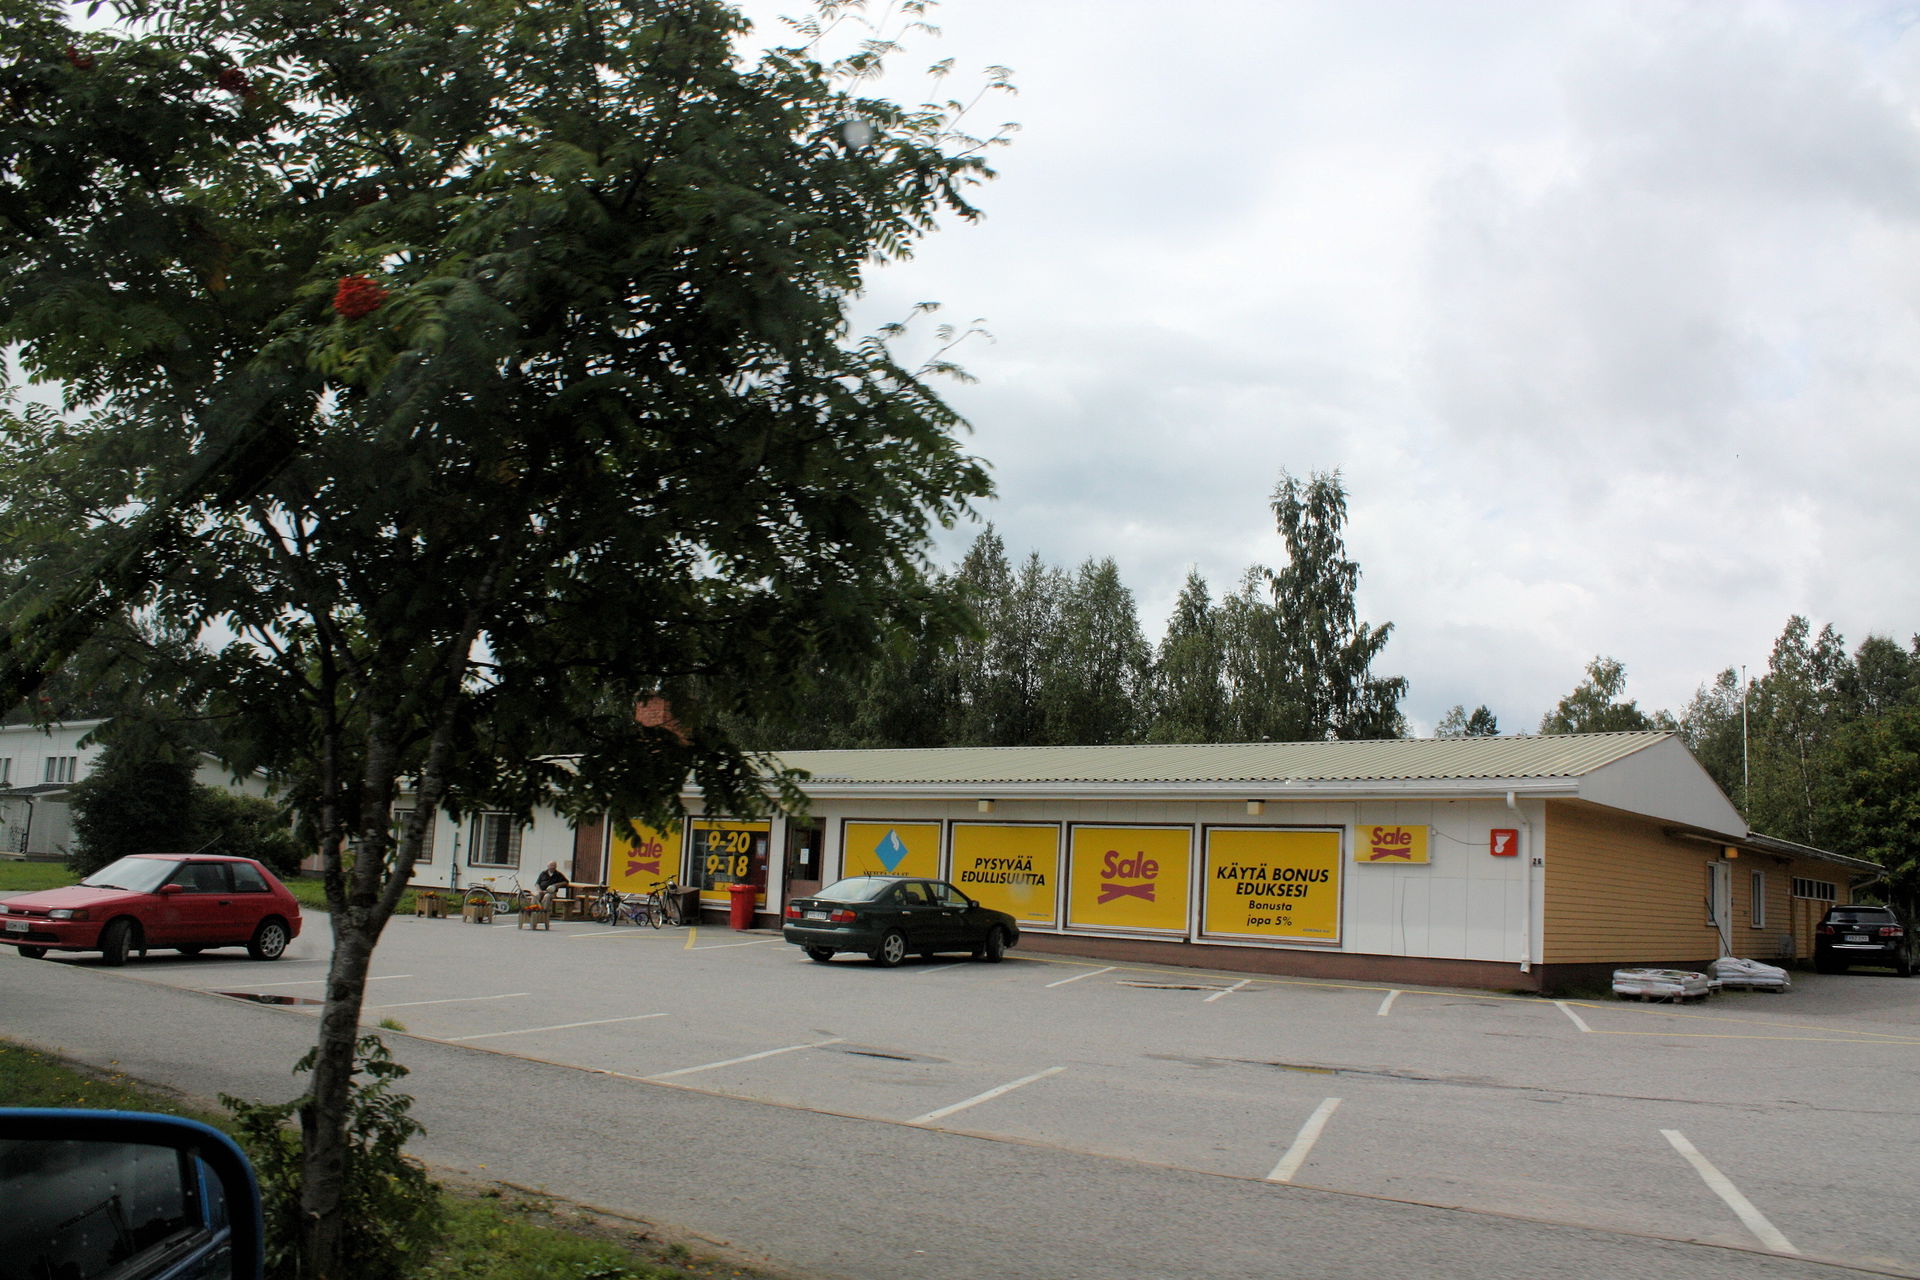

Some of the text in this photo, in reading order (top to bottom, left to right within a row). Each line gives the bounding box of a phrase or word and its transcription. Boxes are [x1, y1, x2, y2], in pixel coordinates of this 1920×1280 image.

[708, 831, 751, 854] 9-20
[1370, 826, 1412, 846] Sale
[706, 855, 749, 877] 9-18
[974, 855, 1033, 871] PYSYVÄÄ
[1100, 850, 1159, 880] Sale
[961, 870, 1046, 886] EDULLISUUTTA
[1217, 862, 1329, 883] KÄYTÄ BONUS
[1235, 883, 1308, 898] EDUKSESI
[1248, 900, 1293, 912] Bonusta
[1246, 914, 1293, 927] jopa 5%
